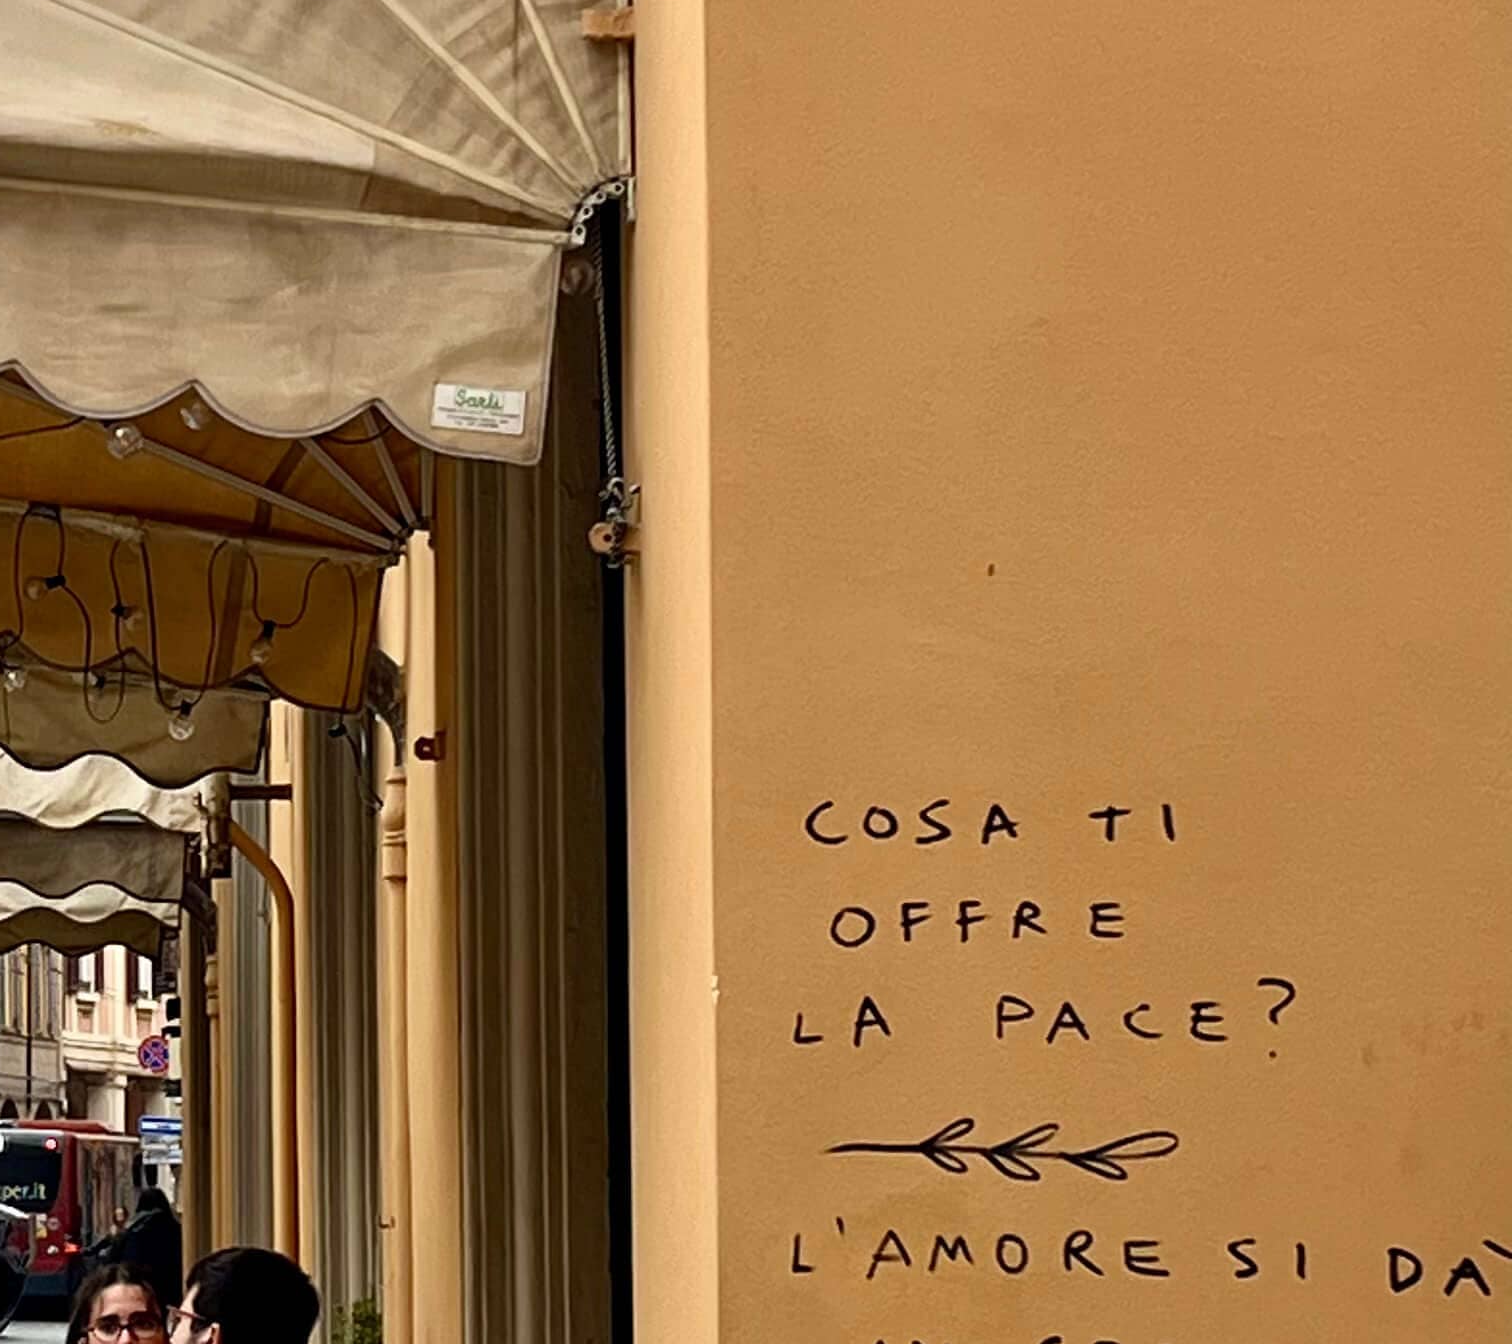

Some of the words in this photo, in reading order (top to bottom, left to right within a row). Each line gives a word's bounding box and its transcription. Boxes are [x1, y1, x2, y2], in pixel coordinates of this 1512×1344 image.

[805, 799, 1018, 845] COSA
[1088, 803, 1175, 842] TI
[830, 900, 1124, 948] OFFRE
[793, 996, 891, 1048] LA
[996, 977, 1296, 1058] PACE?
[791, 1217, 1170, 1280] L'AMORE
[1227, 1238, 1306, 1280] SI
